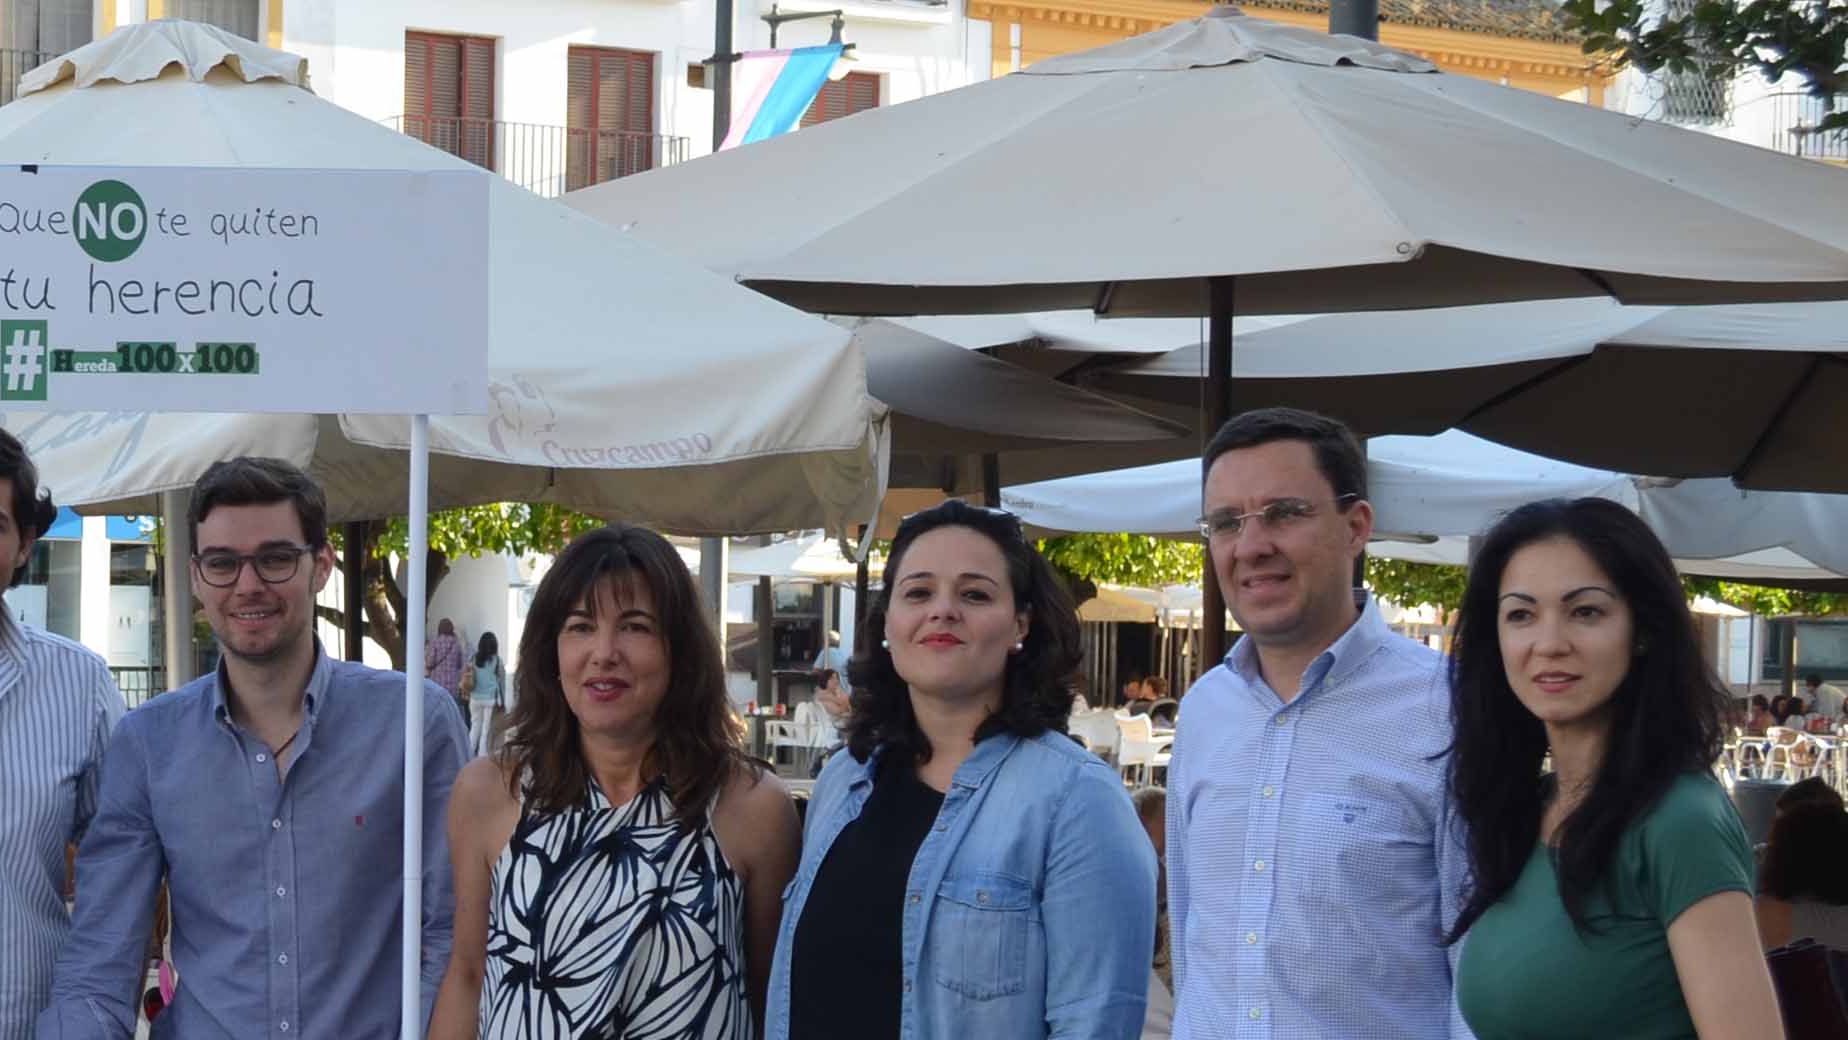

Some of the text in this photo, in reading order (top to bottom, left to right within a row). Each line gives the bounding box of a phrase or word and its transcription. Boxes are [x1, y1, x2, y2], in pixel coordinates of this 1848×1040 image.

[78, 202, 144, 241] NO
[156, 207, 191, 236] te
[210, 207, 319, 245] quiten
[0, 263, 324, 317] tu herencia
